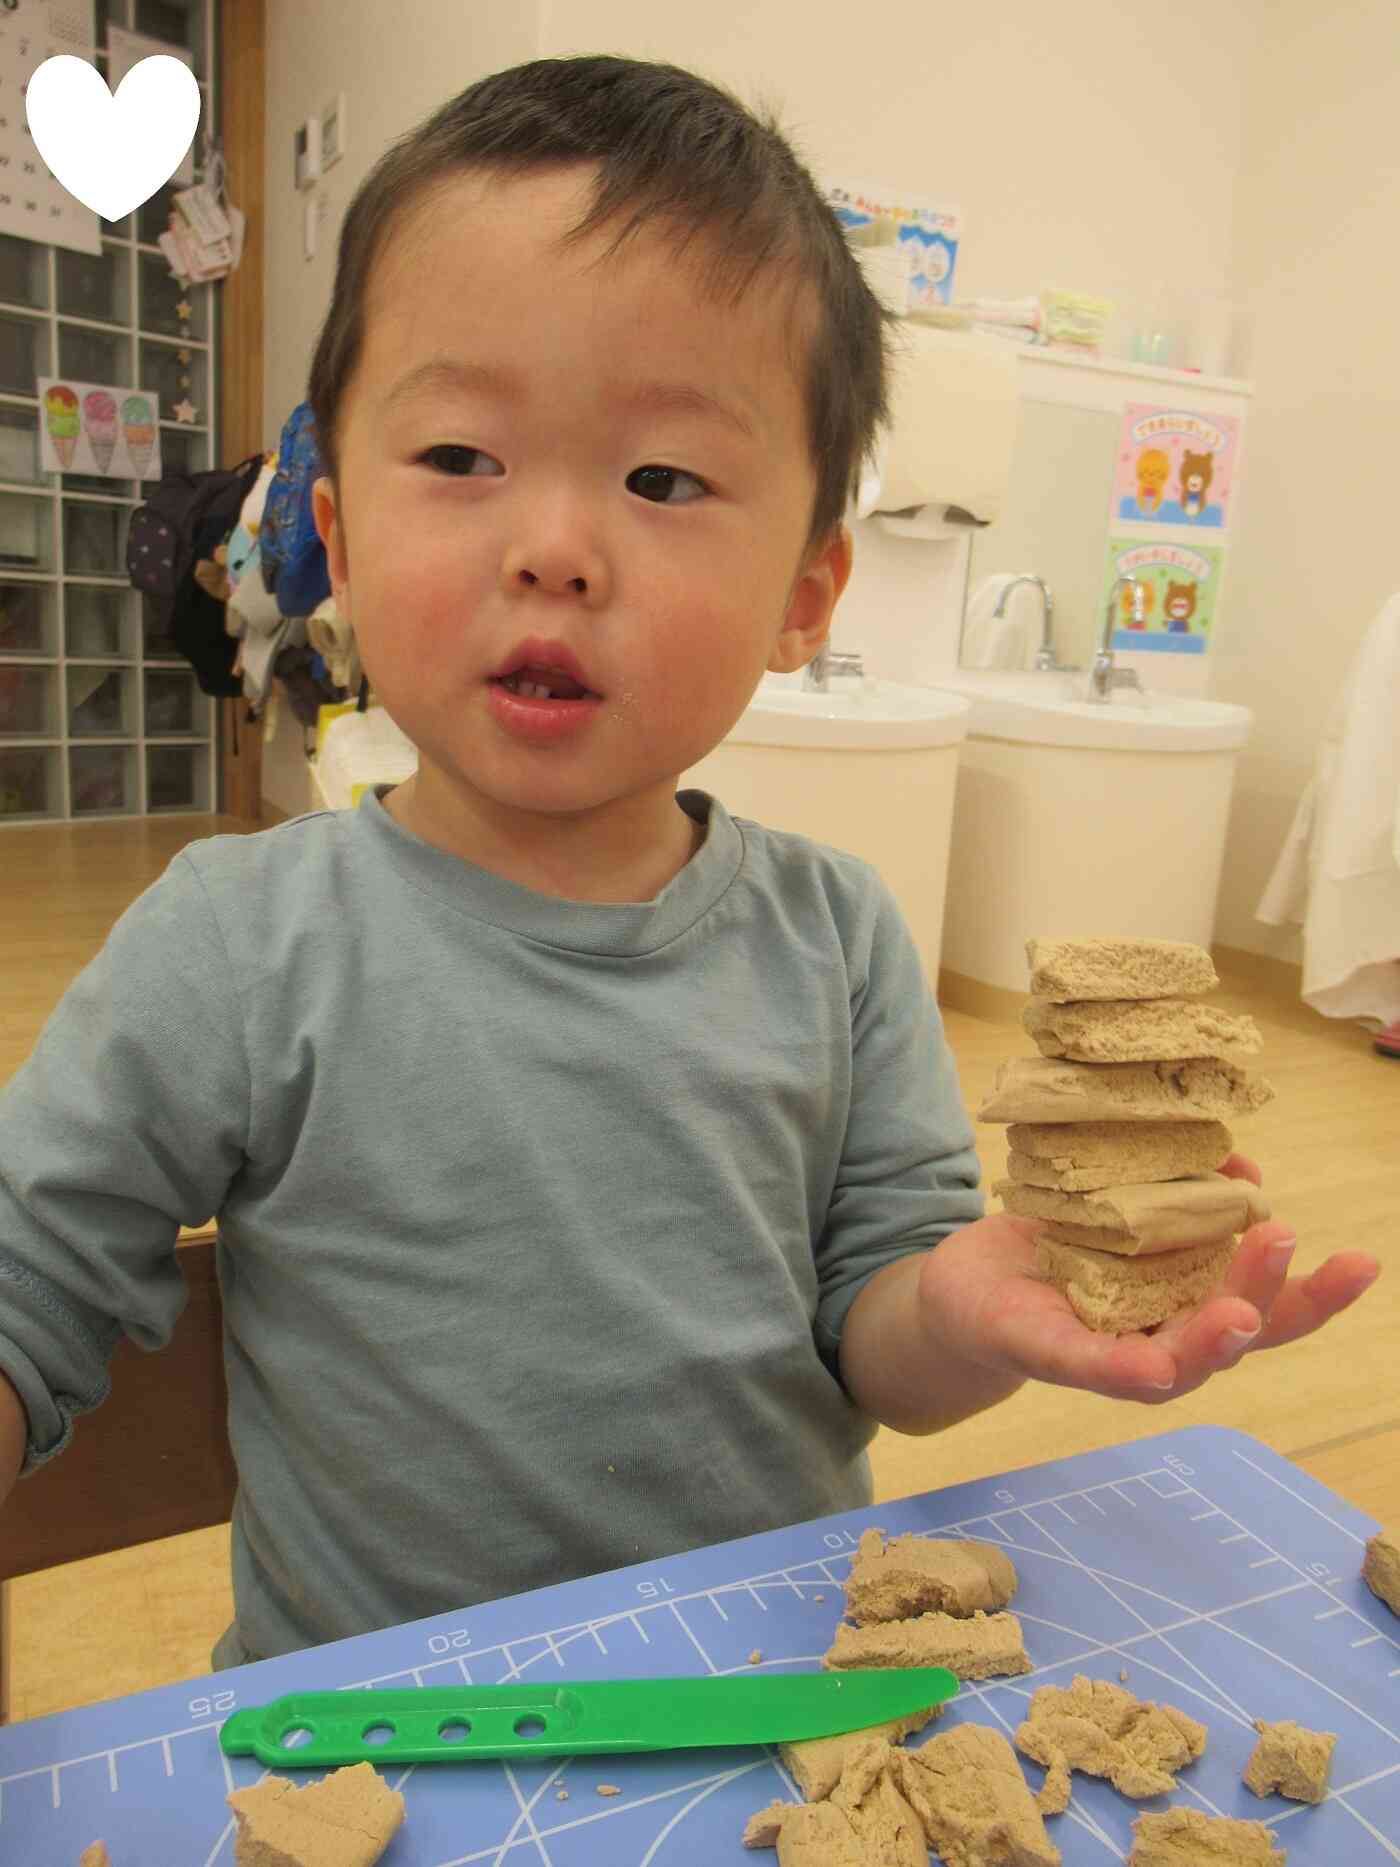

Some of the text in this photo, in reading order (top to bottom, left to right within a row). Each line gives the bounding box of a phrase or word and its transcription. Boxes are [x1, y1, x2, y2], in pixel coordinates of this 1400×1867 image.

[823, 1529, 856, 1549] 10
[637, 1577, 674, 1599] 15
[428, 1629, 471, 1654] 20
[189, 1690, 236, 1718] 25
